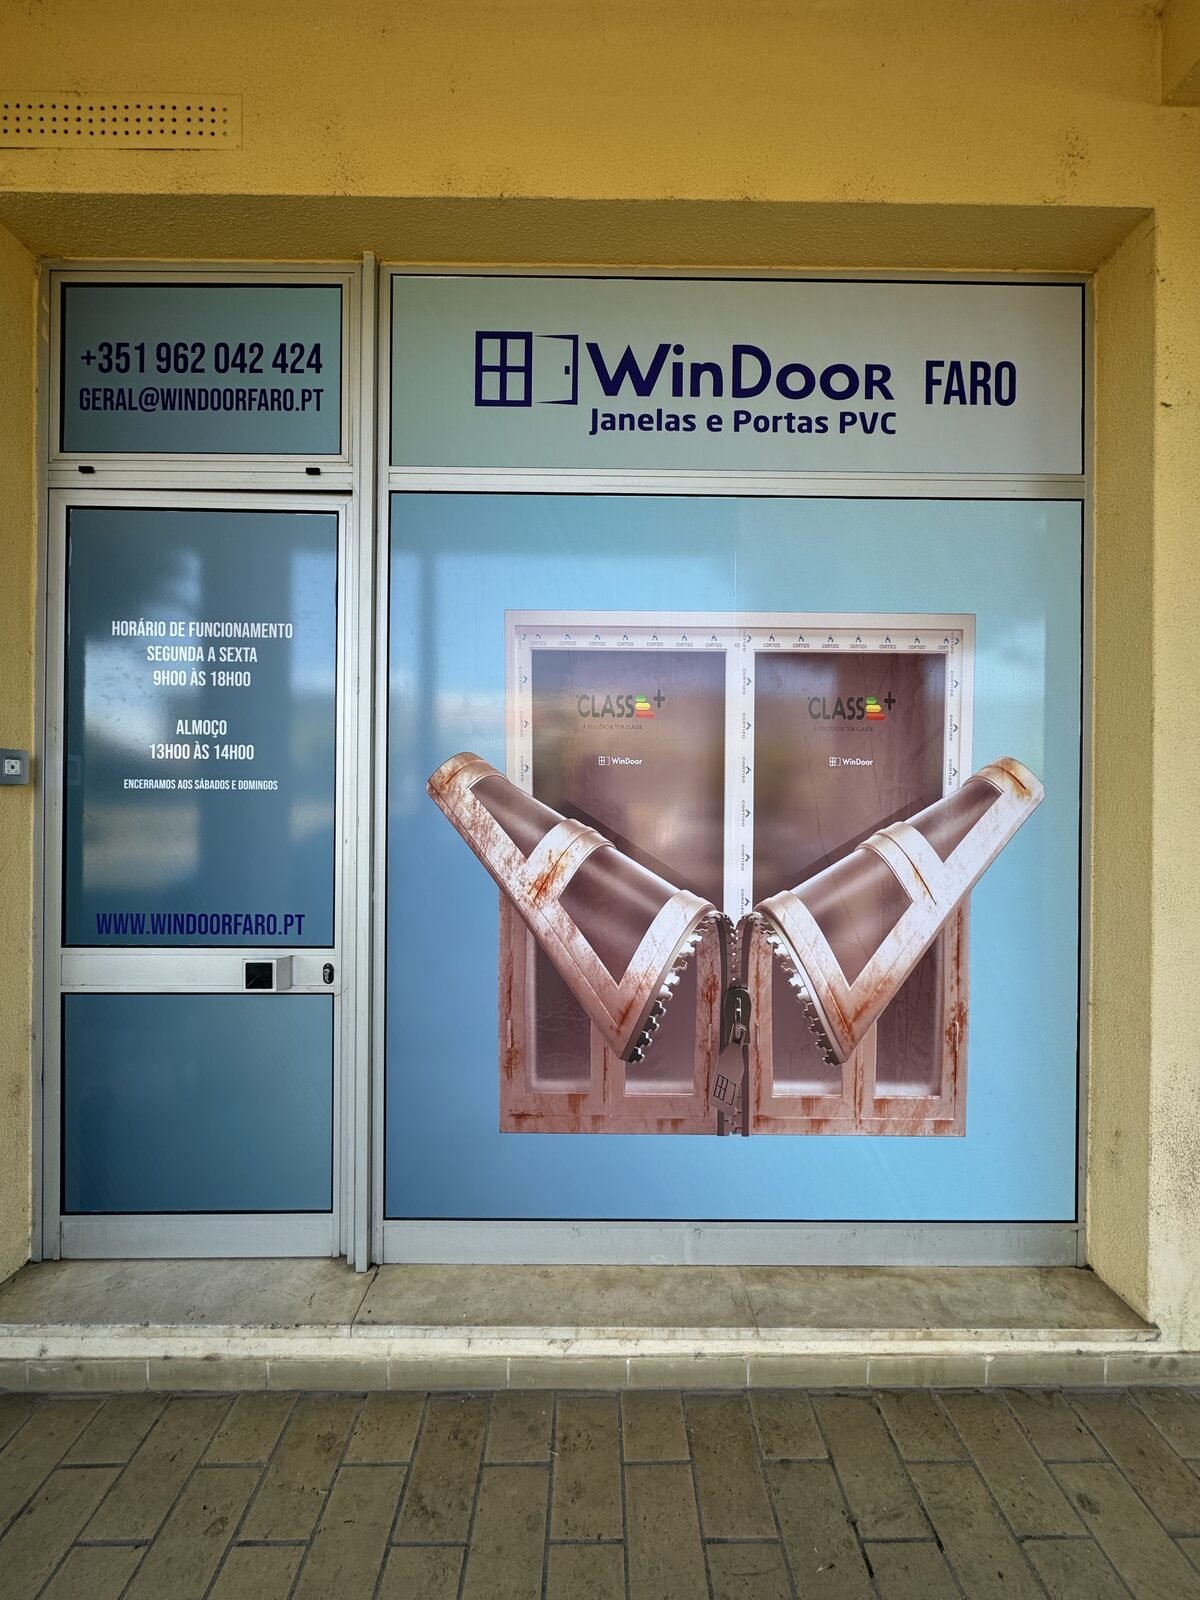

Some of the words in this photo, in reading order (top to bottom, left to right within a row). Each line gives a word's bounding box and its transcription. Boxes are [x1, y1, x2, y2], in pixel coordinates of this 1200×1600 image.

[81, 342, 145, 373] +351
[156, 342, 205, 374] 962
[214, 342, 264, 374] 042
[272, 342, 323, 374] 424
[925, 360, 1017, 406] FARO
[79, 386, 324, 412] GERAL@WINDOORFARO.PT
[589, 407, 697, 436] Janelas
[706, 414, 723, 432] e
[733, 409, 829, 433] Portas
[839, 411, 897, 435] PVC
[111, 618, 166, 637] HORÁRIO
[169, 621, 186, 637] DE
[188, 621, 293, 639] FUNCIONAMENTO
[147, 645, 204, 662] SEGUNDA
[207, 646, 217, 662] A
[219, 646, 258, 662] SEXTA
[153, 670, 187, 686] 9H00
[190, 667, 207, 687] ÀS
[210, 671, 251, 687] 18H00
[176, 719, 228, 738] ALMOÇO
[149, 743, 190, 760] 13H00
[193, 740, 210, 760] ÀS
[213, 744, 255, 760] 14H00
[611, 757, 643, 765] WinDoor
[842, 758, 874, 766] WinDoor
[123, 778, 176, 790] ENCERRAMOS
[177, 779, 193, 790] AOS
[194, 777, 230, 790] SÁBADOS
[231, 779, 237, 790] E
[238, 779, 279, 791] DOMINGOS
[96, 912, 306, 936] WWW.WINDOORFARO.PT
